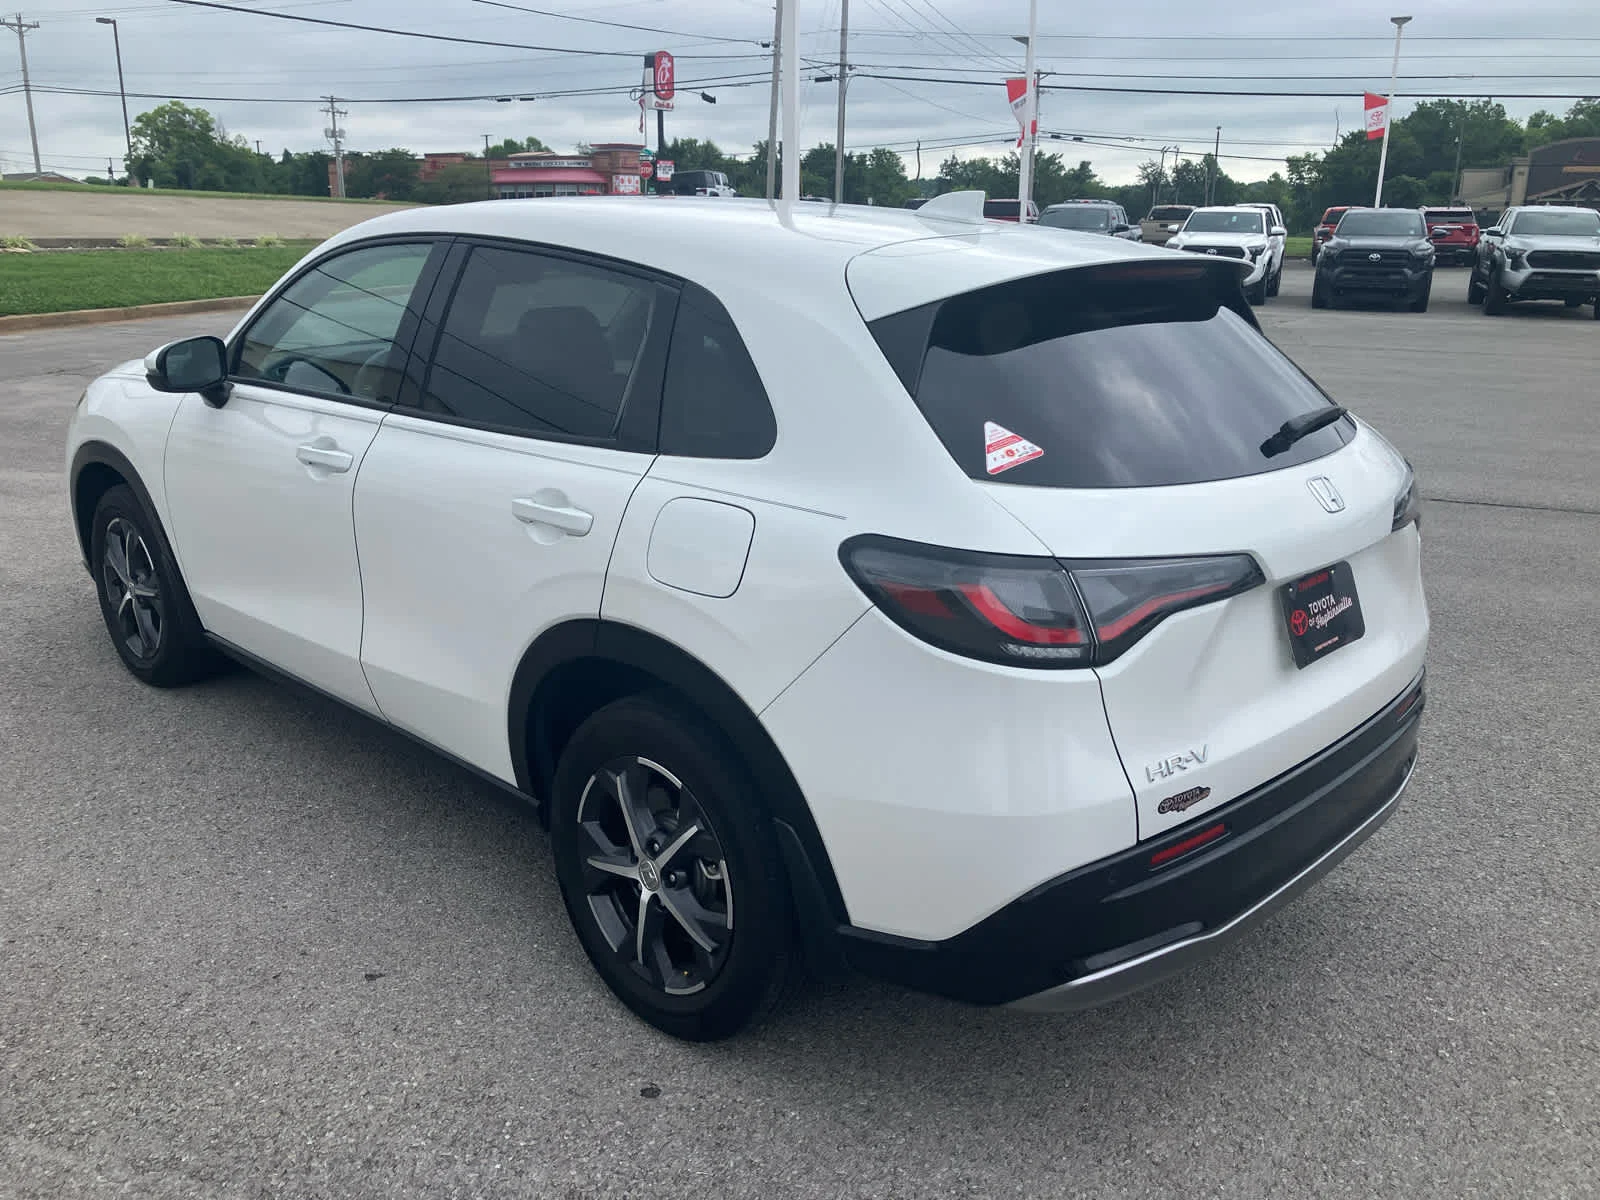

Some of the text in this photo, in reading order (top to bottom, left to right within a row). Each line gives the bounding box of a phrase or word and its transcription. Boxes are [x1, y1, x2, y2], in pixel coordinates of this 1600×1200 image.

[1308, 594, 1336, 615] TOYOTA
[1315, 596, 1353, 629] Hopkinsville
[1145, 743, 1208, 783] HR-V
